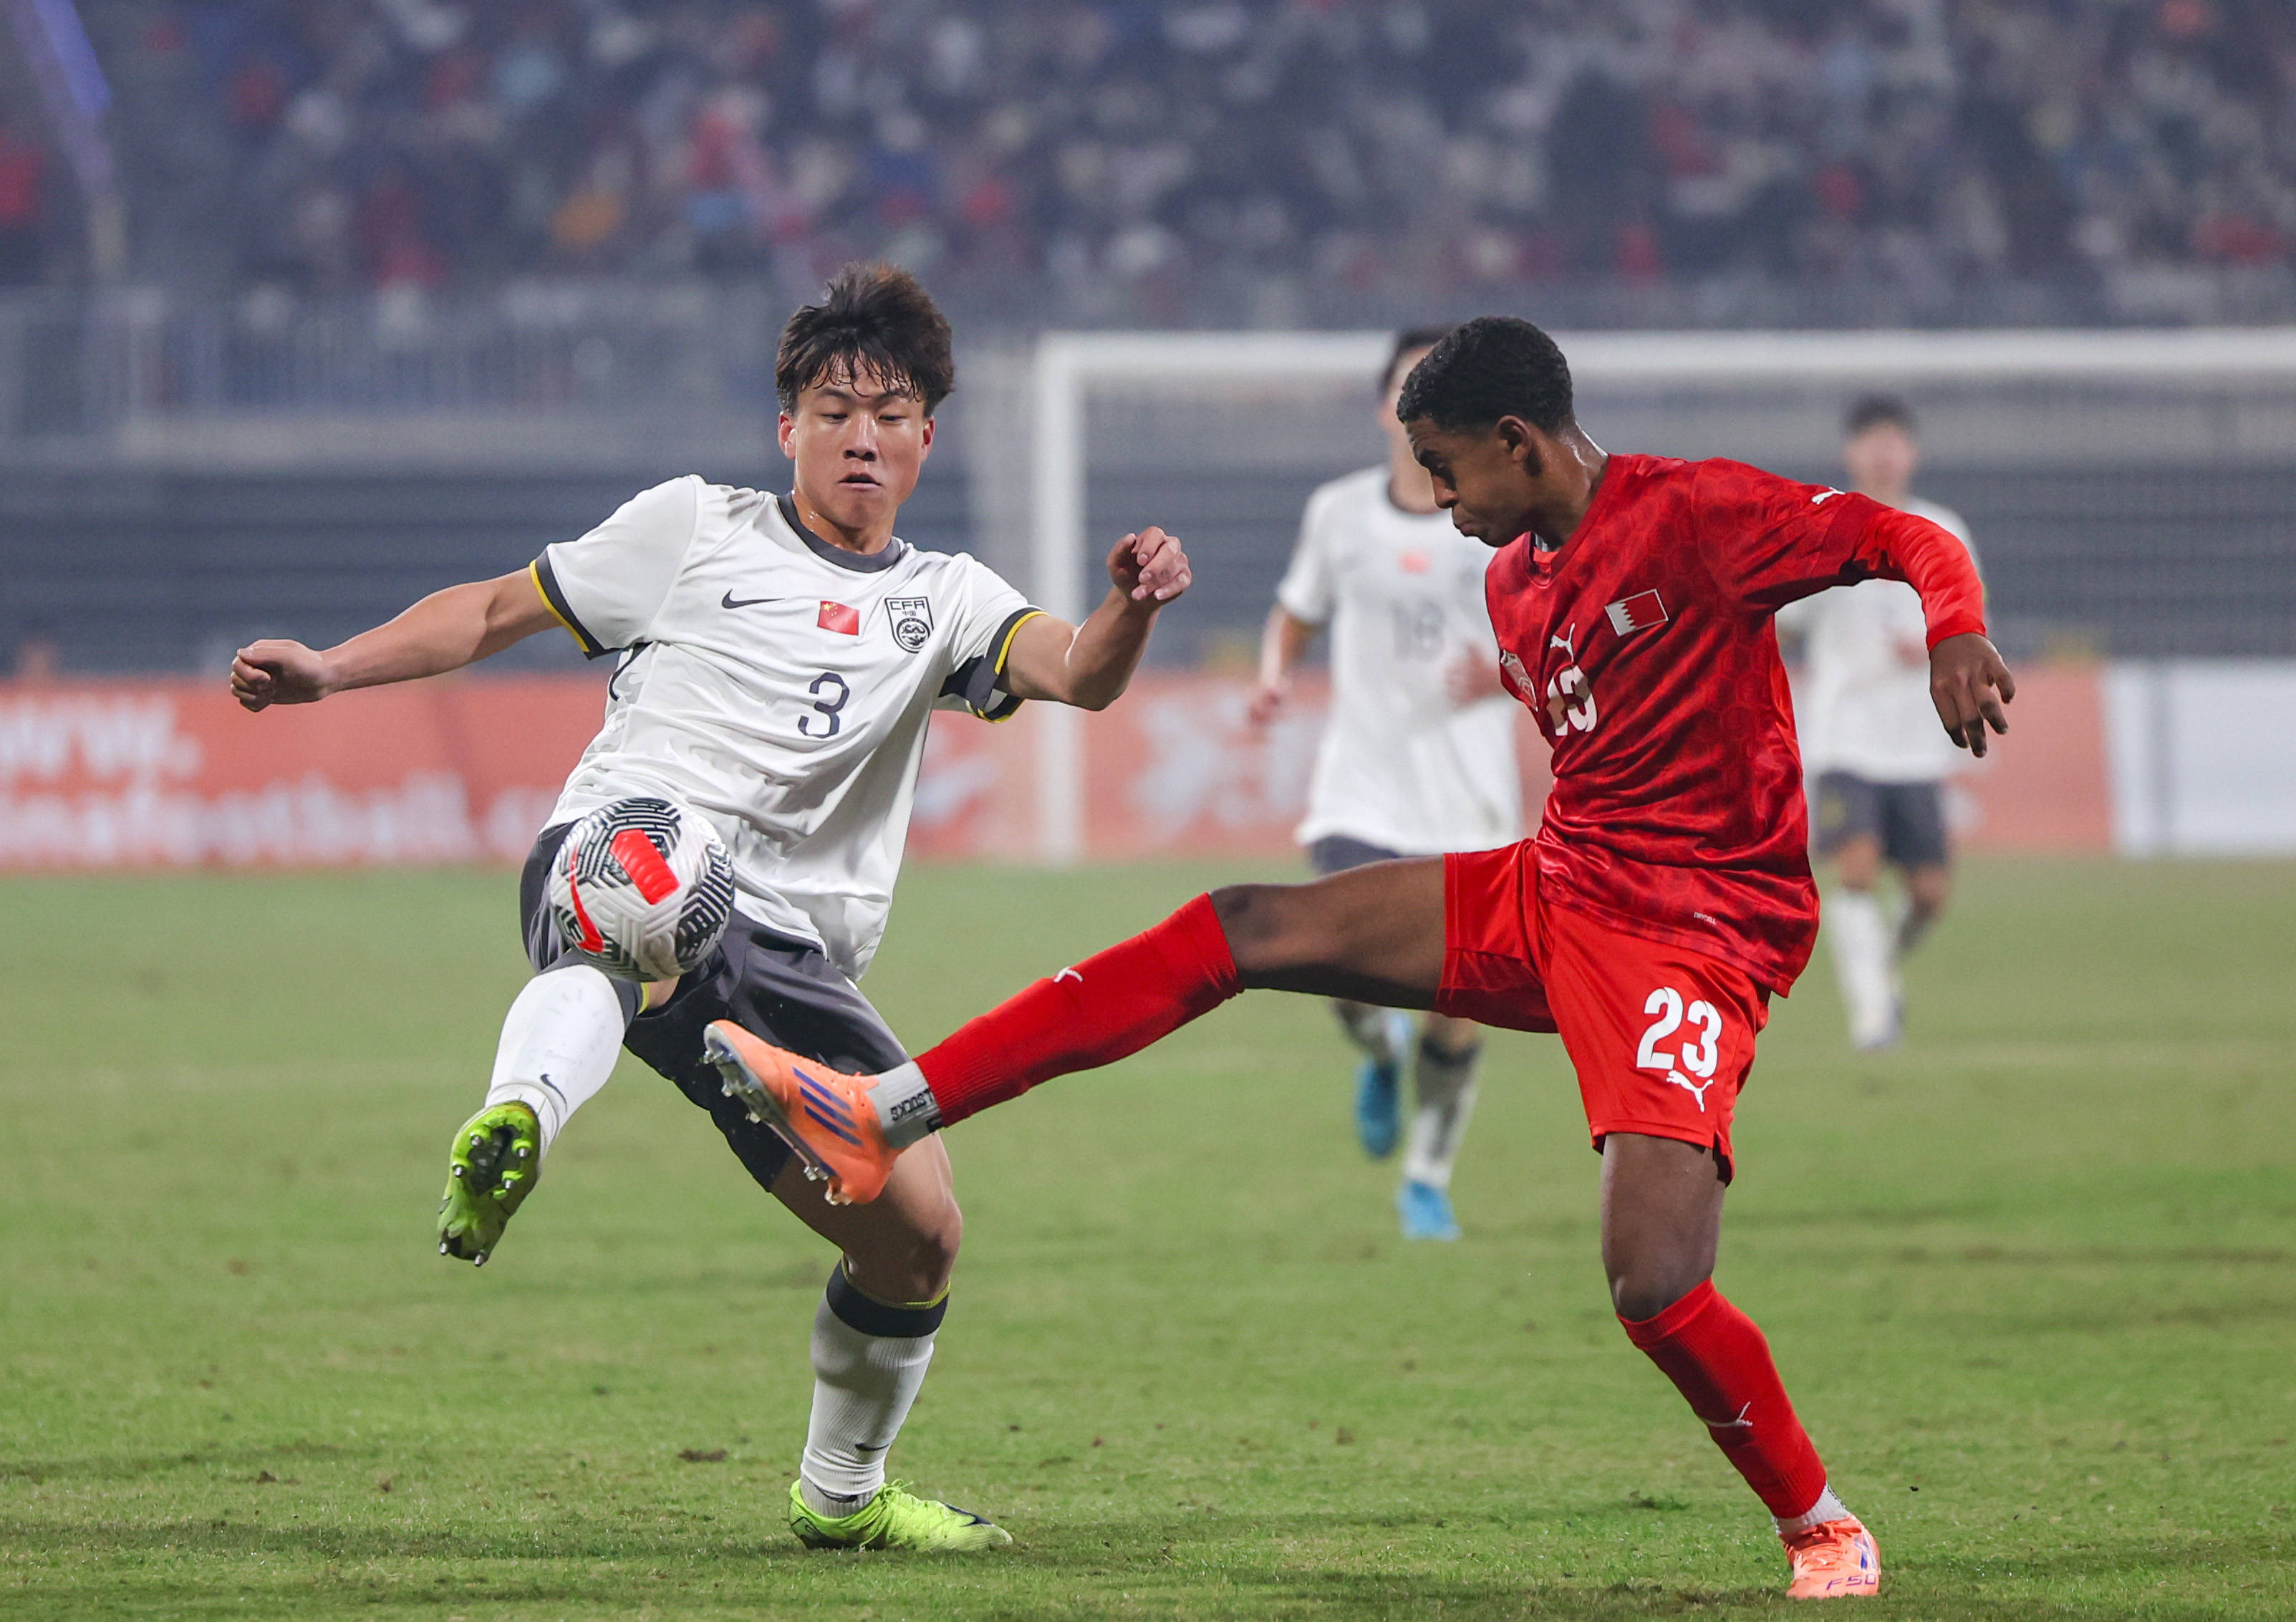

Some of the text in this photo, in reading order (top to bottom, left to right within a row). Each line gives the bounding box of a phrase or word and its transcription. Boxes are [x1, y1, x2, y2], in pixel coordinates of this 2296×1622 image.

[889, 600, 925, 610] CFA
[797, 672, 850, 739] 3
[1636, 986, 1722, 1078] 23
